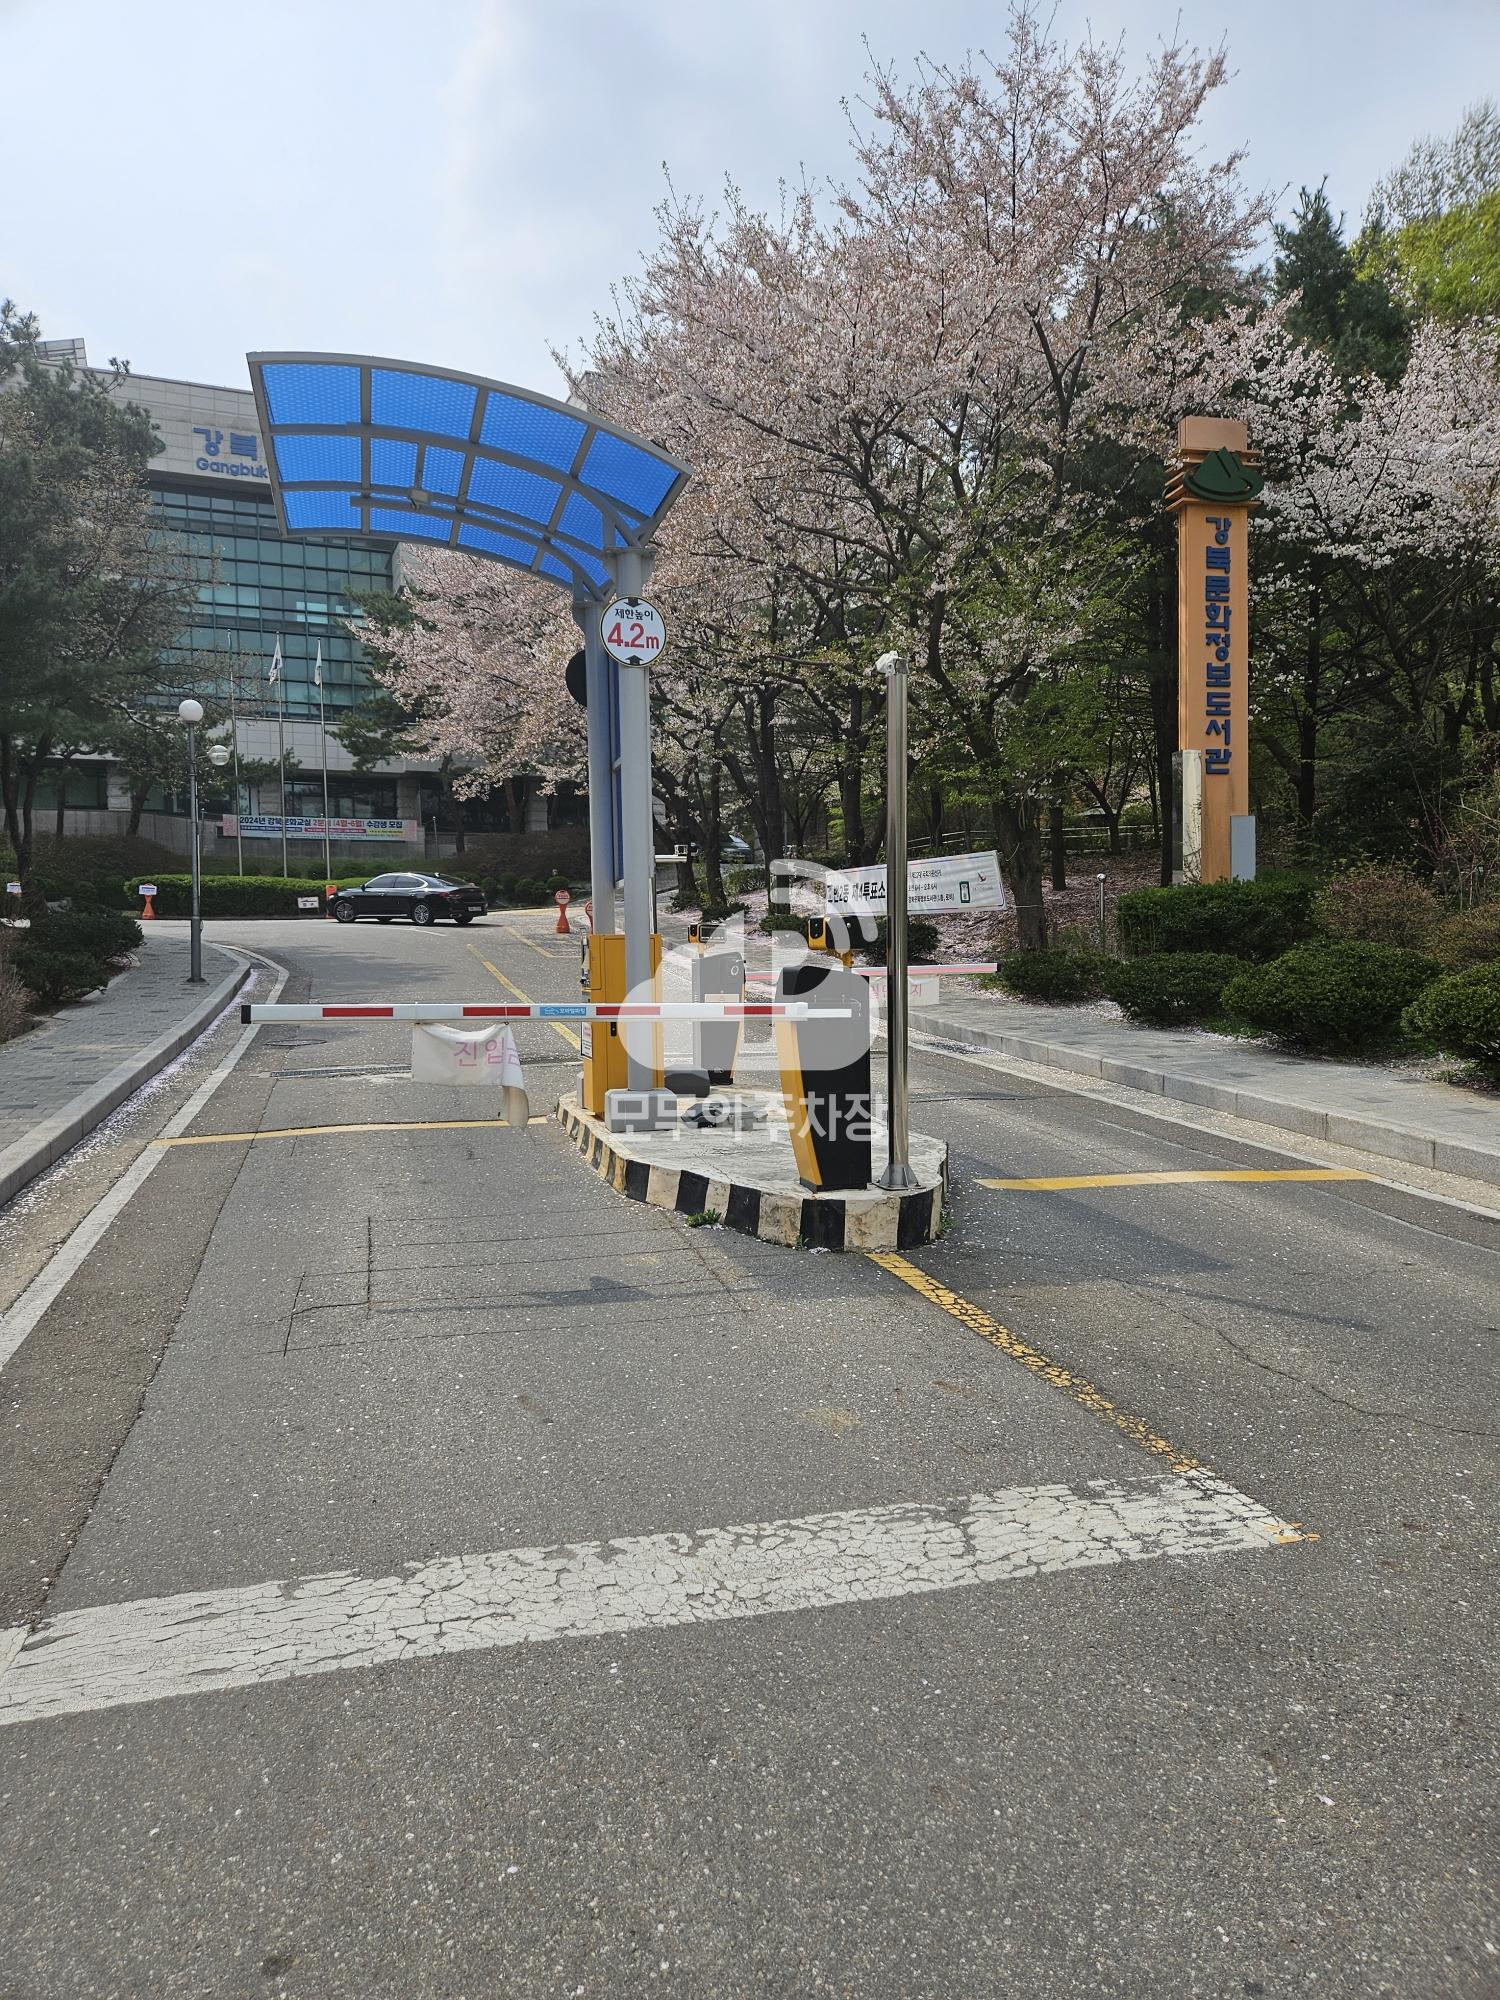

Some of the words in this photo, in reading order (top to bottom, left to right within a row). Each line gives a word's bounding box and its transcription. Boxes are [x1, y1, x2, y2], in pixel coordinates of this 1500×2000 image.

[193, 428, 257, 461] 강북
[196, 457, 268, 478] Gangbuk
[615, 608, 653, 621] 제한높이
[607, 622, 660, 649] 4.2m
[1205, 516, 1232, 775] 강북문화정보도서관
[240, 816, 266, 824] 2024년
[367, 820, 387, 828] 수강생
[389, 820, 403, 829] 모집
